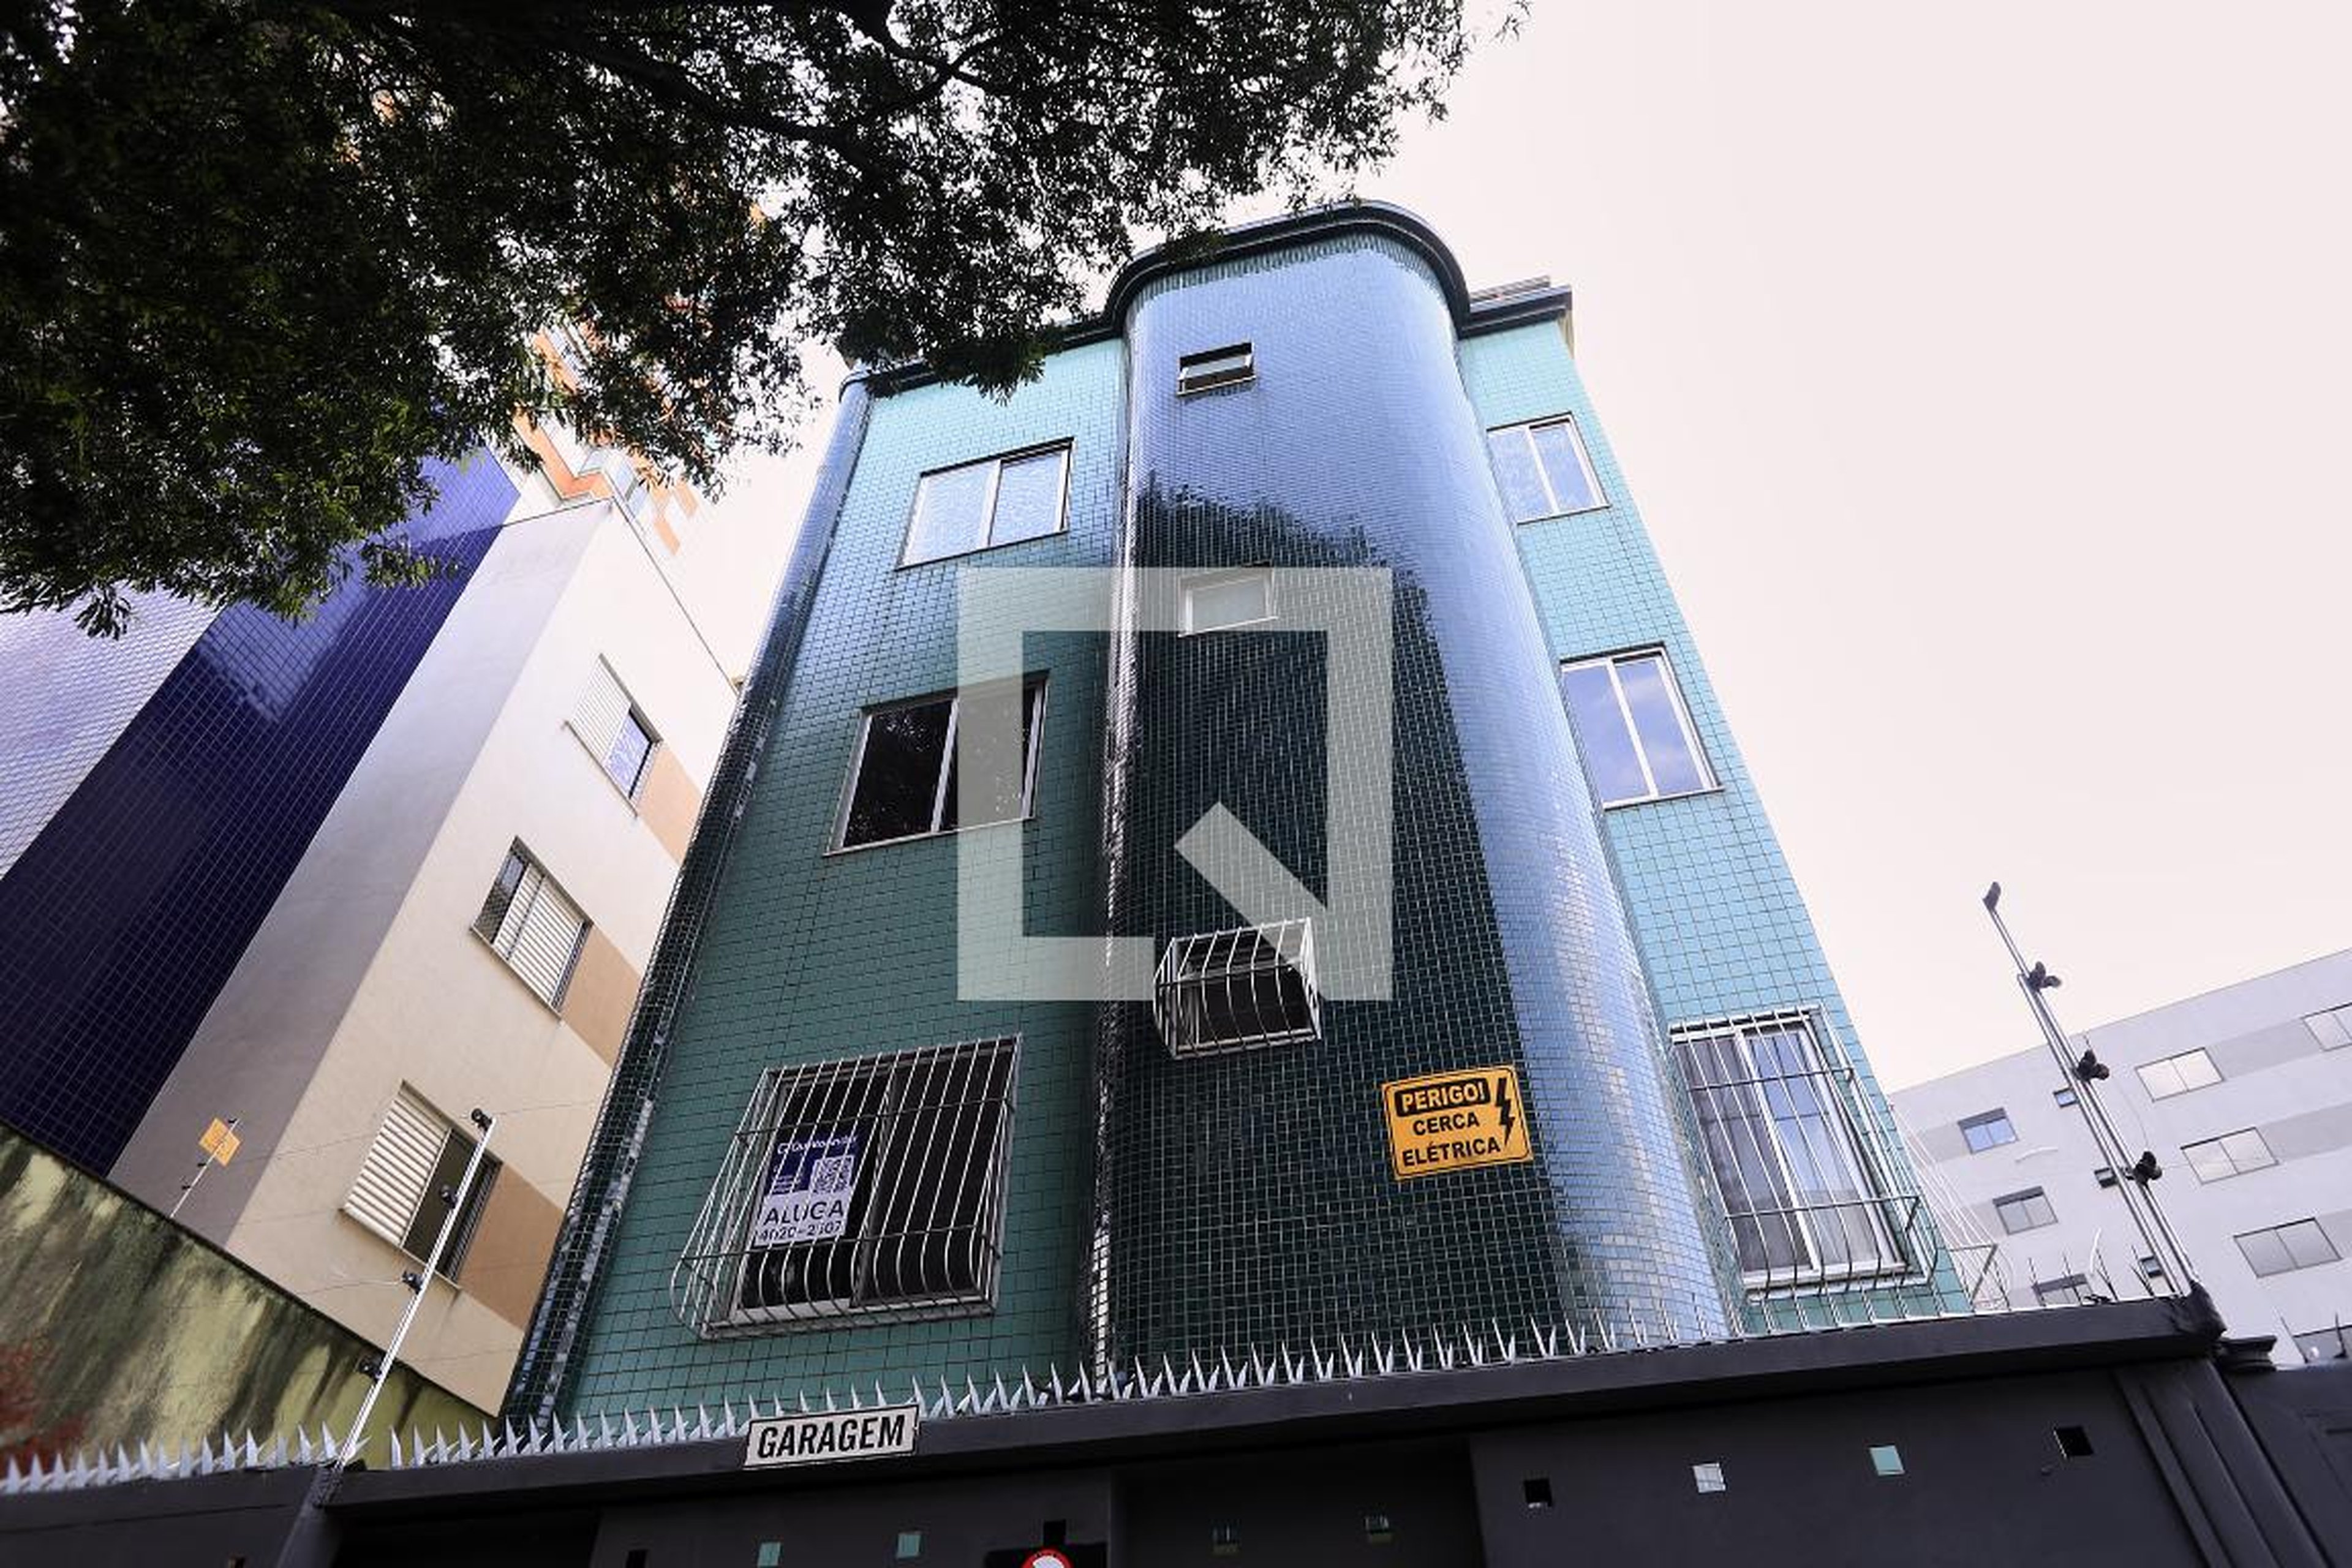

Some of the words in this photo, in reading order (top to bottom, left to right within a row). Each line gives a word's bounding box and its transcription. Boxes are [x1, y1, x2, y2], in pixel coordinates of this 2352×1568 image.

[1402, 1082, 1485, 1112] PERIGO!
[1412, 1112, 1480, 1136] CERCA
[1402, 1137, 1501, 1167] ELÉTRICA
[758, 1414, 905, 1458] GARAGEM
